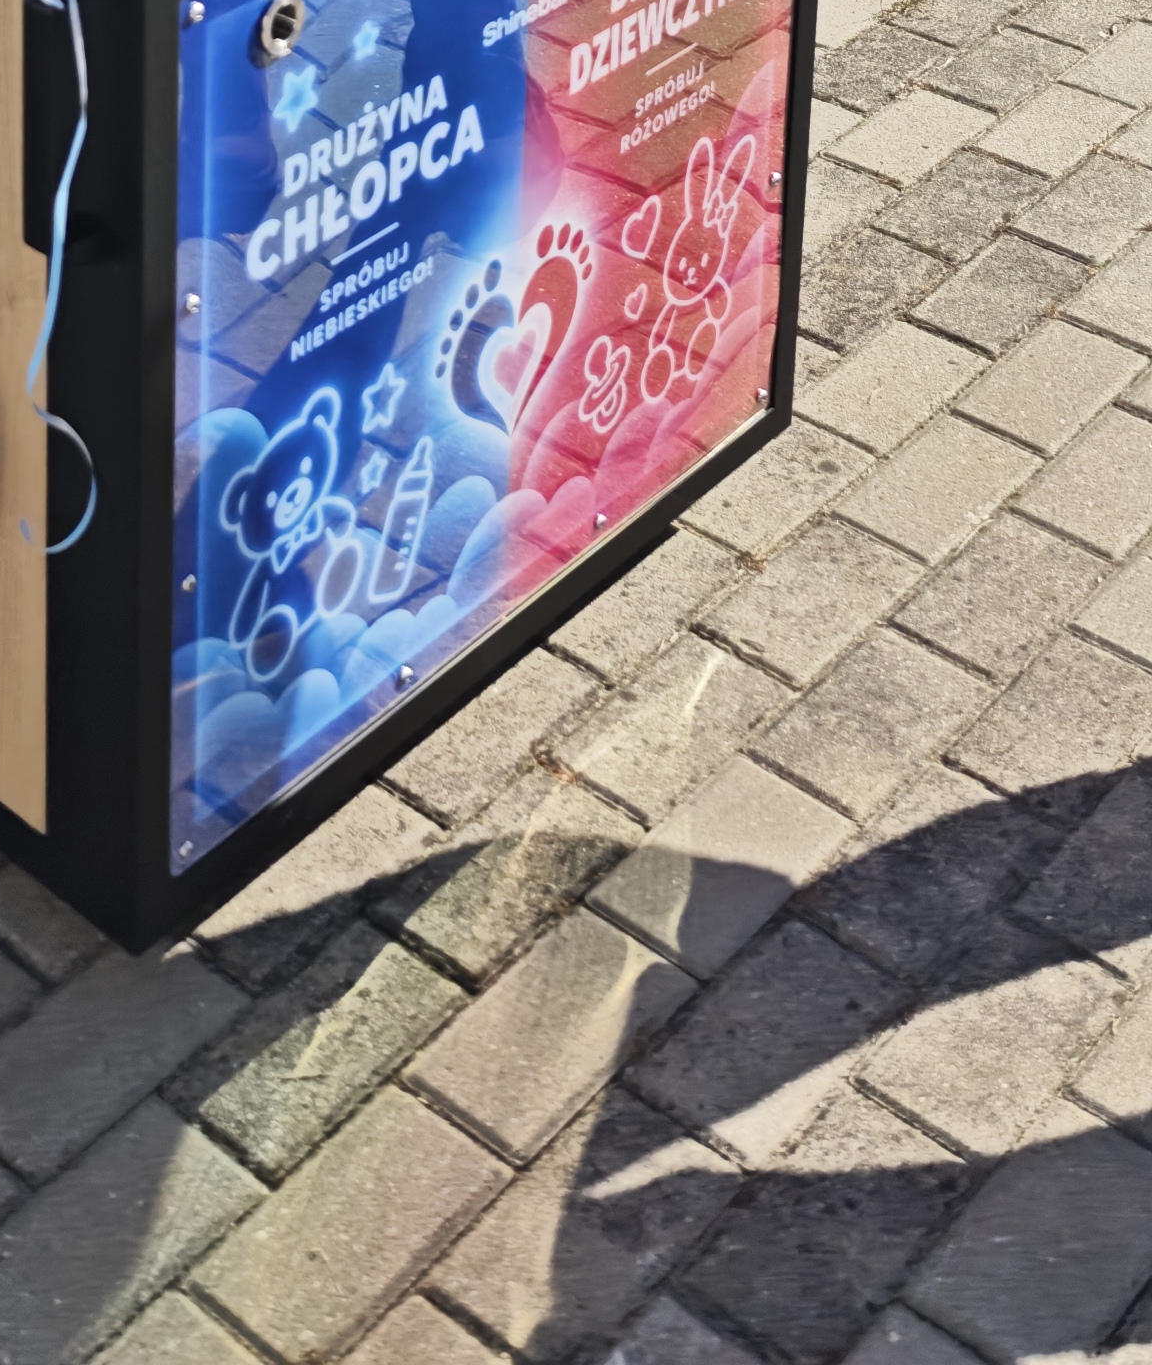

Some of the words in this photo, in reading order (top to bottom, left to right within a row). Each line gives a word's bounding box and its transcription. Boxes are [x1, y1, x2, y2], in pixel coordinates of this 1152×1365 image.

[619, 80, 717, 155] RÓŻOWEGO!
[634, 60, 705, 118] SPRÓBUJ
[282, 73, 449, 199] DRUŻYNA
[245, 104, 485, 282] CHŁOPCA
[289, 255, 435, 363] NIEBIESKIEGO!
[319, 240, 410, 314] SPRÓBUJ
